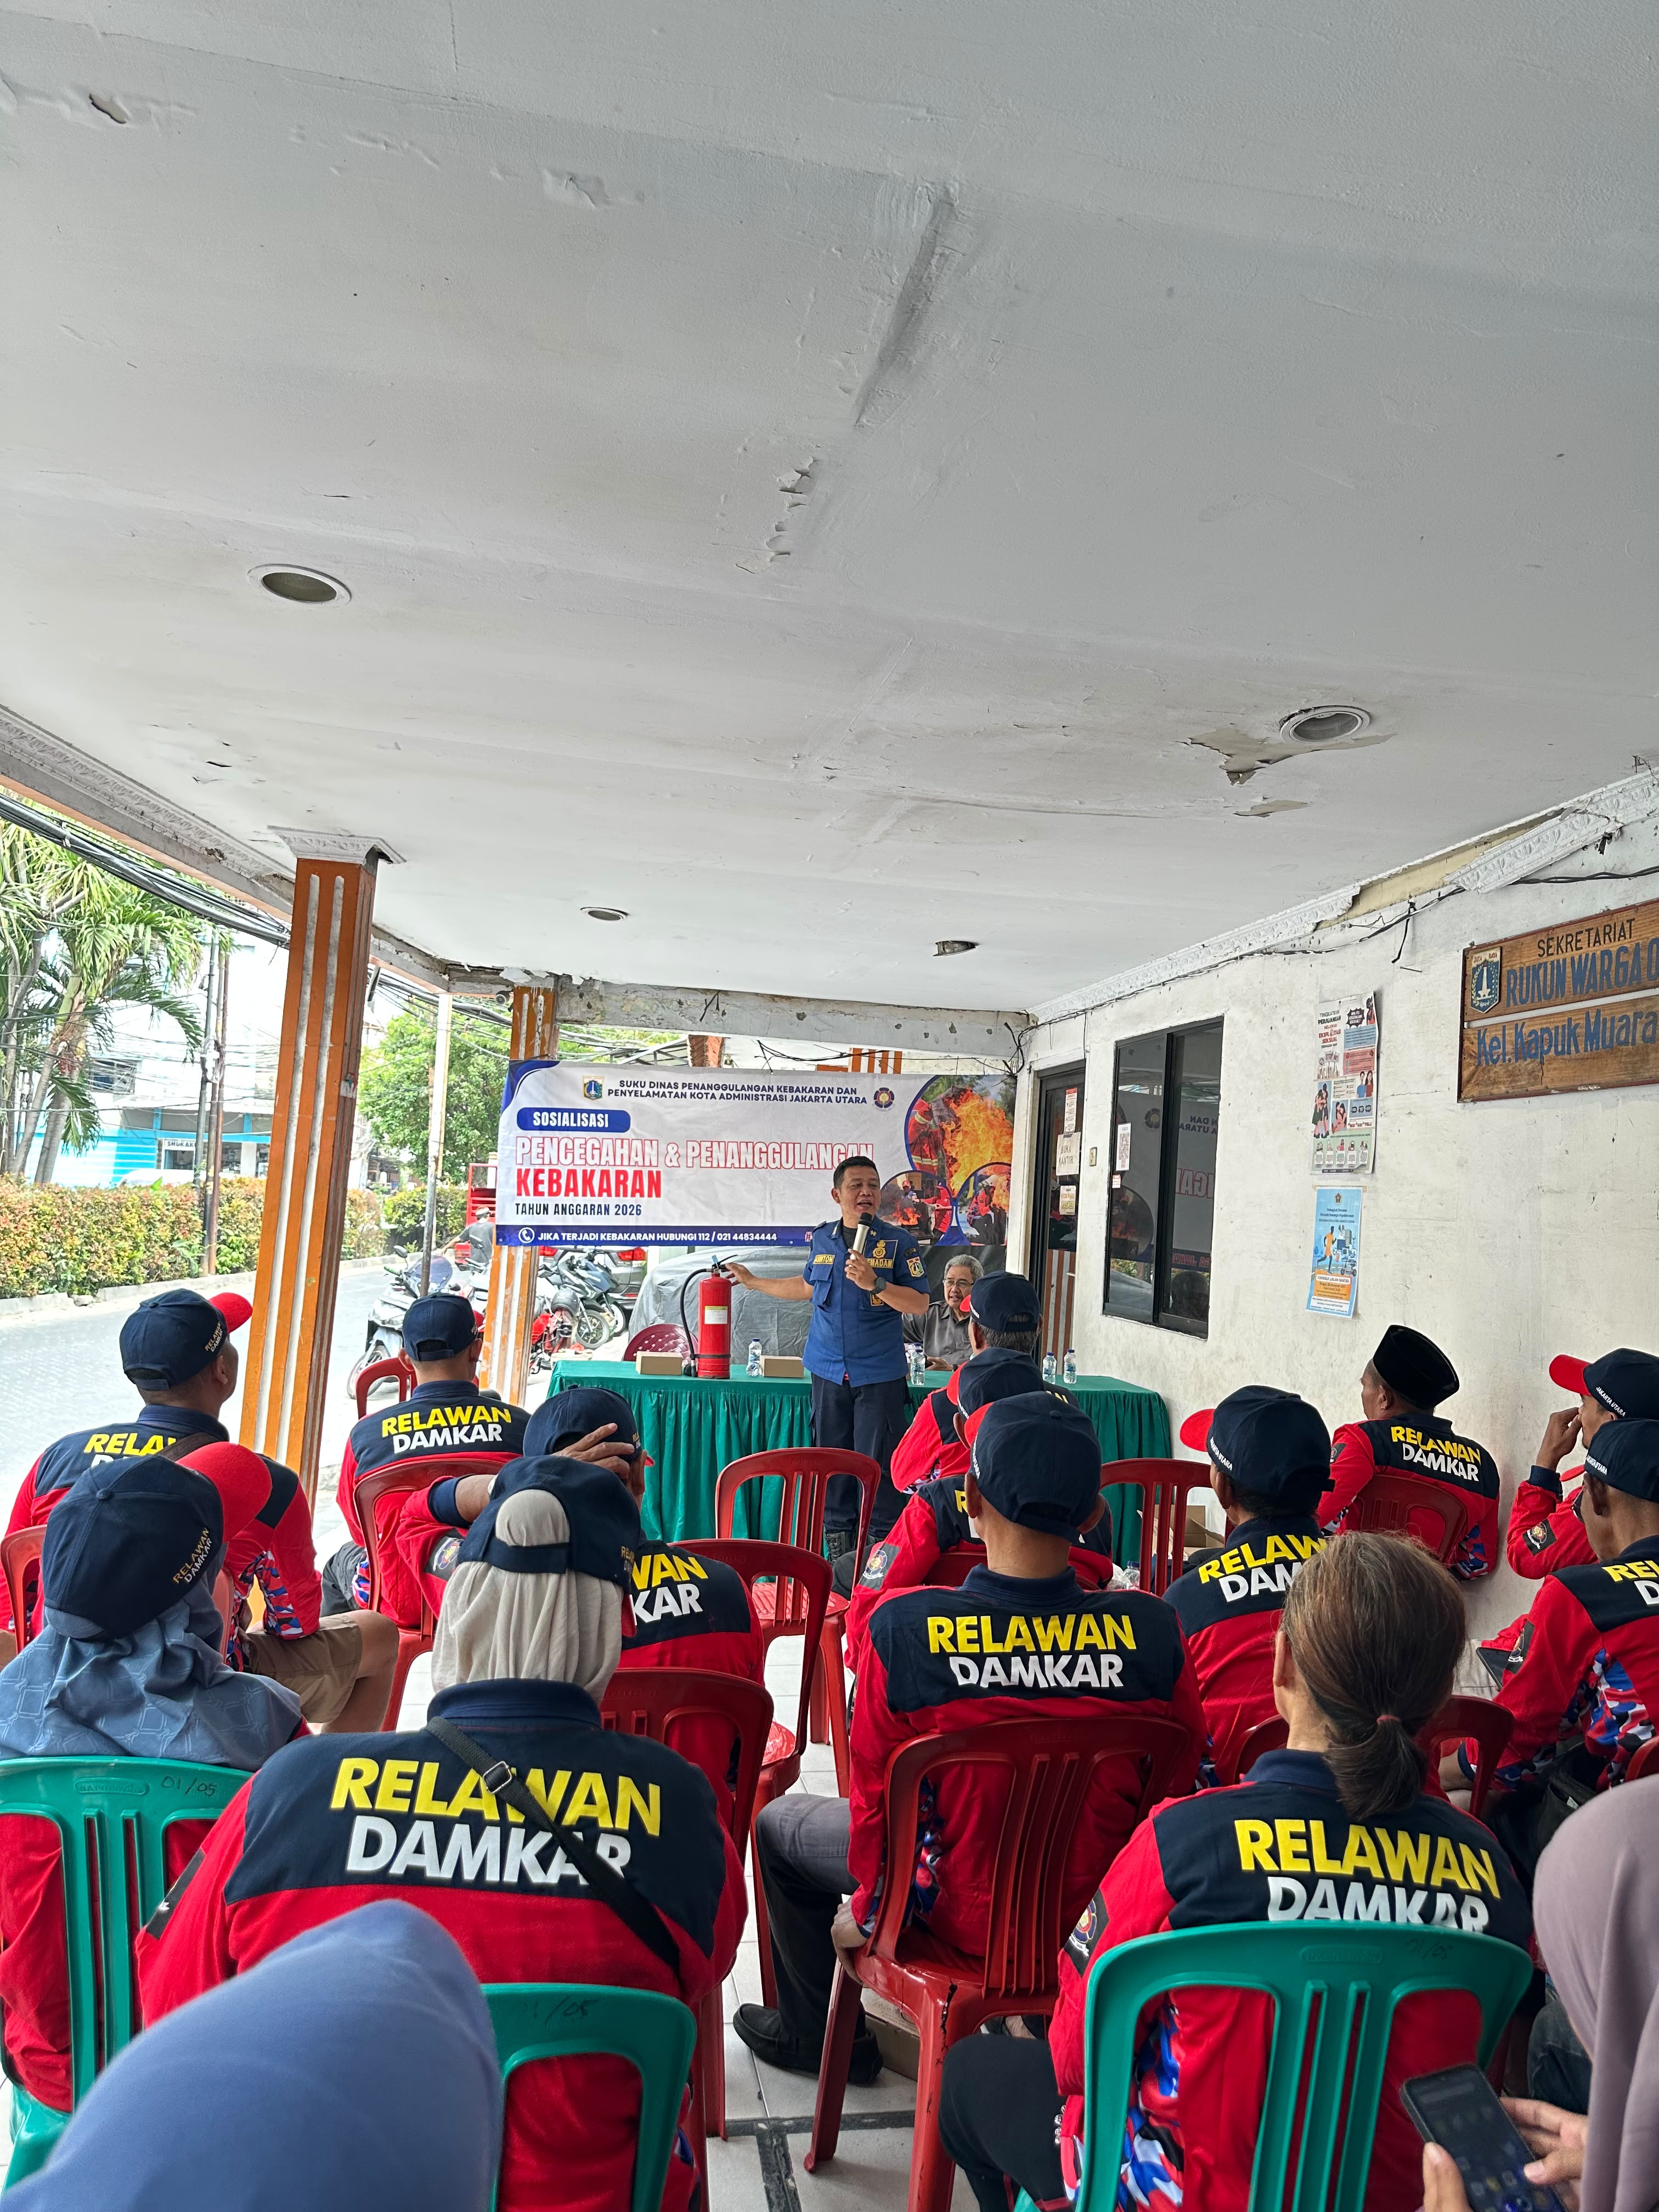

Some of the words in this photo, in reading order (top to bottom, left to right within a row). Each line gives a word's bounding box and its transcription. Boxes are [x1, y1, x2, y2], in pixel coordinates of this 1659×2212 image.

[1538, 918, 1635, 957] SEKRETARIAT
[1506, 958, 1566, 1008] RUKUN
[1571, 942, 1642, 996] WARGA
[1477, 1025, 1512, 1067] Kel.
[1515, 1017, 1581, 1064] Kapuk
[1584, 1009, 1658, 1052] Muara
[608, 1088, 687, 1099] PENYELAMATAN
[690, 1091, 716, 1100] KOTA
[719, 1091, 788, 1102] ADMINISTRASI
[789, 1095, 833, 1103] JAKARTA
[836, 1096, 867, 1104] UTARA
[619, 1080, 647, 1088] SUKU
[649, 1081, 679, 1090] DINAS
[681, 1082, 774, 1093] PENANGGULANGAN
[777, 1086, 834, 1094] KEBAKARAN
[837, 1087, 857, 1095] DAN
[533, 1111, 609, 1128] SOSIALISASI
[516, 1136, 658, 1167] PENCEGAHAN
[665, 1142, 680, 1168] &
[516, 1168, 662, 1198] KEBAKARAN
[516, 1203, 549, 1215] TAHUN
[554, 1204, 610, 1216] ANGGARAN
[614, 1204, 642, 1216] 2026
[538, 1232, 560, 1241] JIKA
[561, 1232, 599, 1241] TERJADI
[600, 1233, 656, 1241] KEBAKARAN
[657, 1233, 697, 1241] HUBUNGI
[698, 1233, 710, 1241] 112
[711, 1232, 716, 1243] /
[717, 1233, 731, 1241] 021
[732, 1233, 777, 1241] 44834444
[1596, 1386, 1612, 1405] JAKARTA
[1611, 1402, 1626, 1417] UTARA
[382, 1406, 511, 1437] RELAWAN
[83, 1432, 176, 1456] RELA
[393, 1424, 503, 1454] DAMKAR
[1392, 1426, 1481, 1466] RELAWAN
[1218, 1452, 1233, 1471] UTARA
[1402, 1443, 1480, 1483] DAMKAR
[173, 1527, 209, 1584] RELAWAN
[184, 1538, 212, 1583] DAMKAR
[927, 1614, 1137, 1654] RELAWAN
[949, 1654, 1124, 1688] DAMKAR
[161, 1775, 217, 1797] 01/05
[330, 1757, 661, 1837] RELAWAN
[1234, 1819, 1500, 1900] RELAWAN
[1267, 1876, 1489, 1933] DAMKAR
